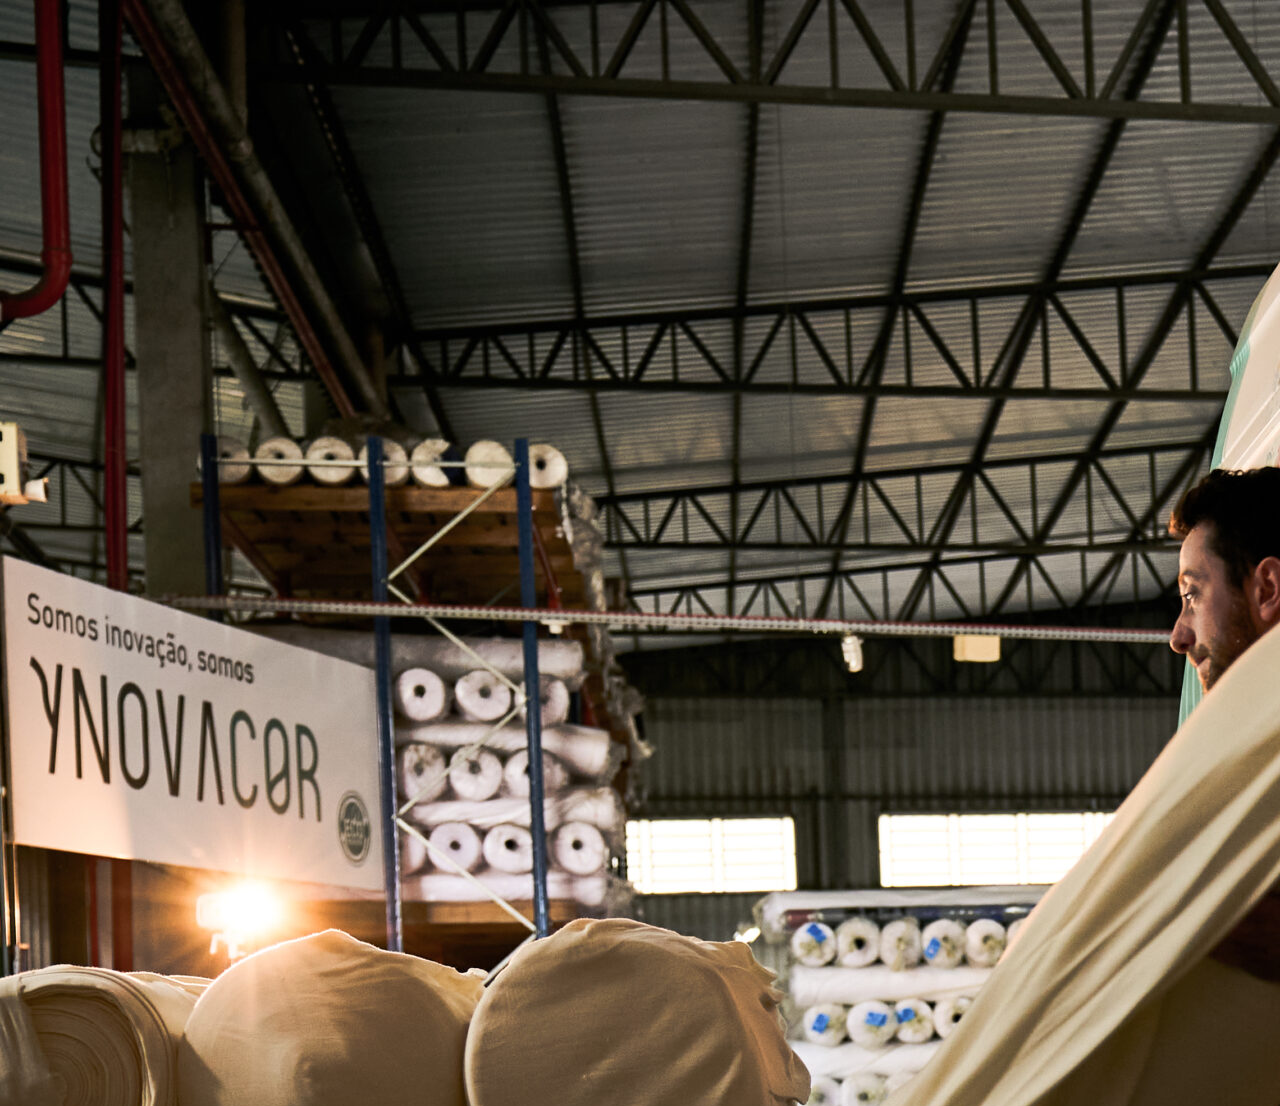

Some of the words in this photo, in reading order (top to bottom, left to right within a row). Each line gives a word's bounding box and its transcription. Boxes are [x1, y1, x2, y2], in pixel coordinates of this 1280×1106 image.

[27, 592, 99, 641] Somos
[104, 615, 193, 671] inovação,
[197, 649, 255, 684] somos
